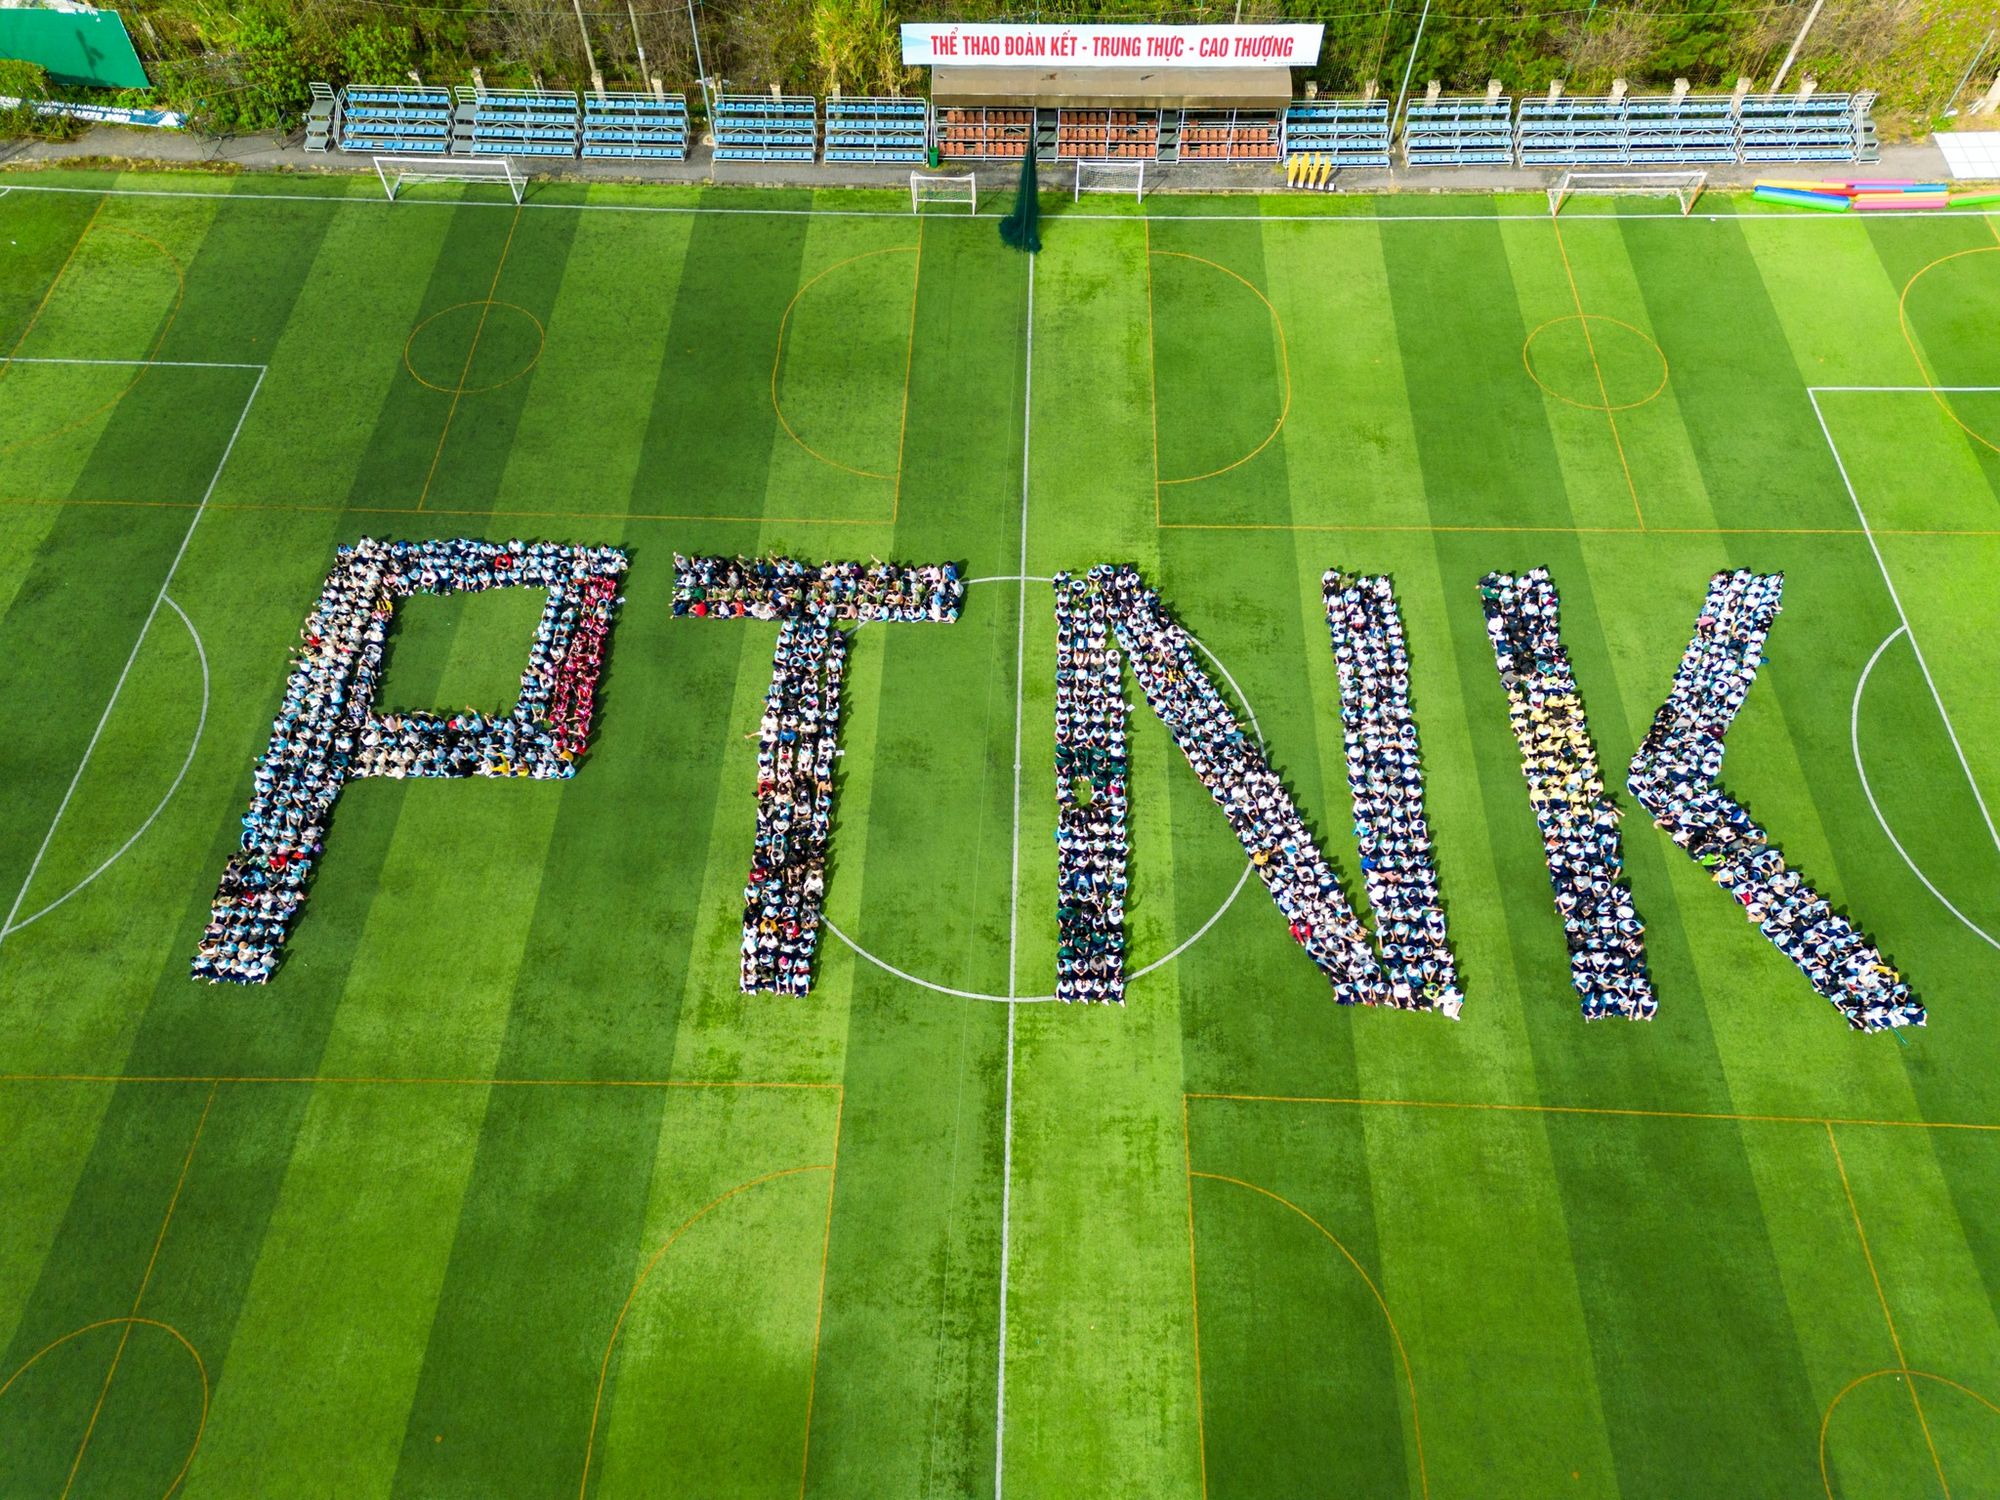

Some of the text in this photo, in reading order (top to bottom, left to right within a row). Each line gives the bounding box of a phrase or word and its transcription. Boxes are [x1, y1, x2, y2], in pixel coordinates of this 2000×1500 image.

[931, 27, 959, 56] THỂ
[962, 35, 1000, 56] THAO
[1004, 32, 1045, 56] ĐOÀN
[1050, 30, 1077, 57] KẾT
[1093, 36, 1142, 57] TRUNG
[1146, 35, 1184, 61] THỰC
[1199, 37, 1229, 57] CAO
[1234, 35, 1294, 62] THƯỢNG
[190, 536, 1928, 1034] PTNK
